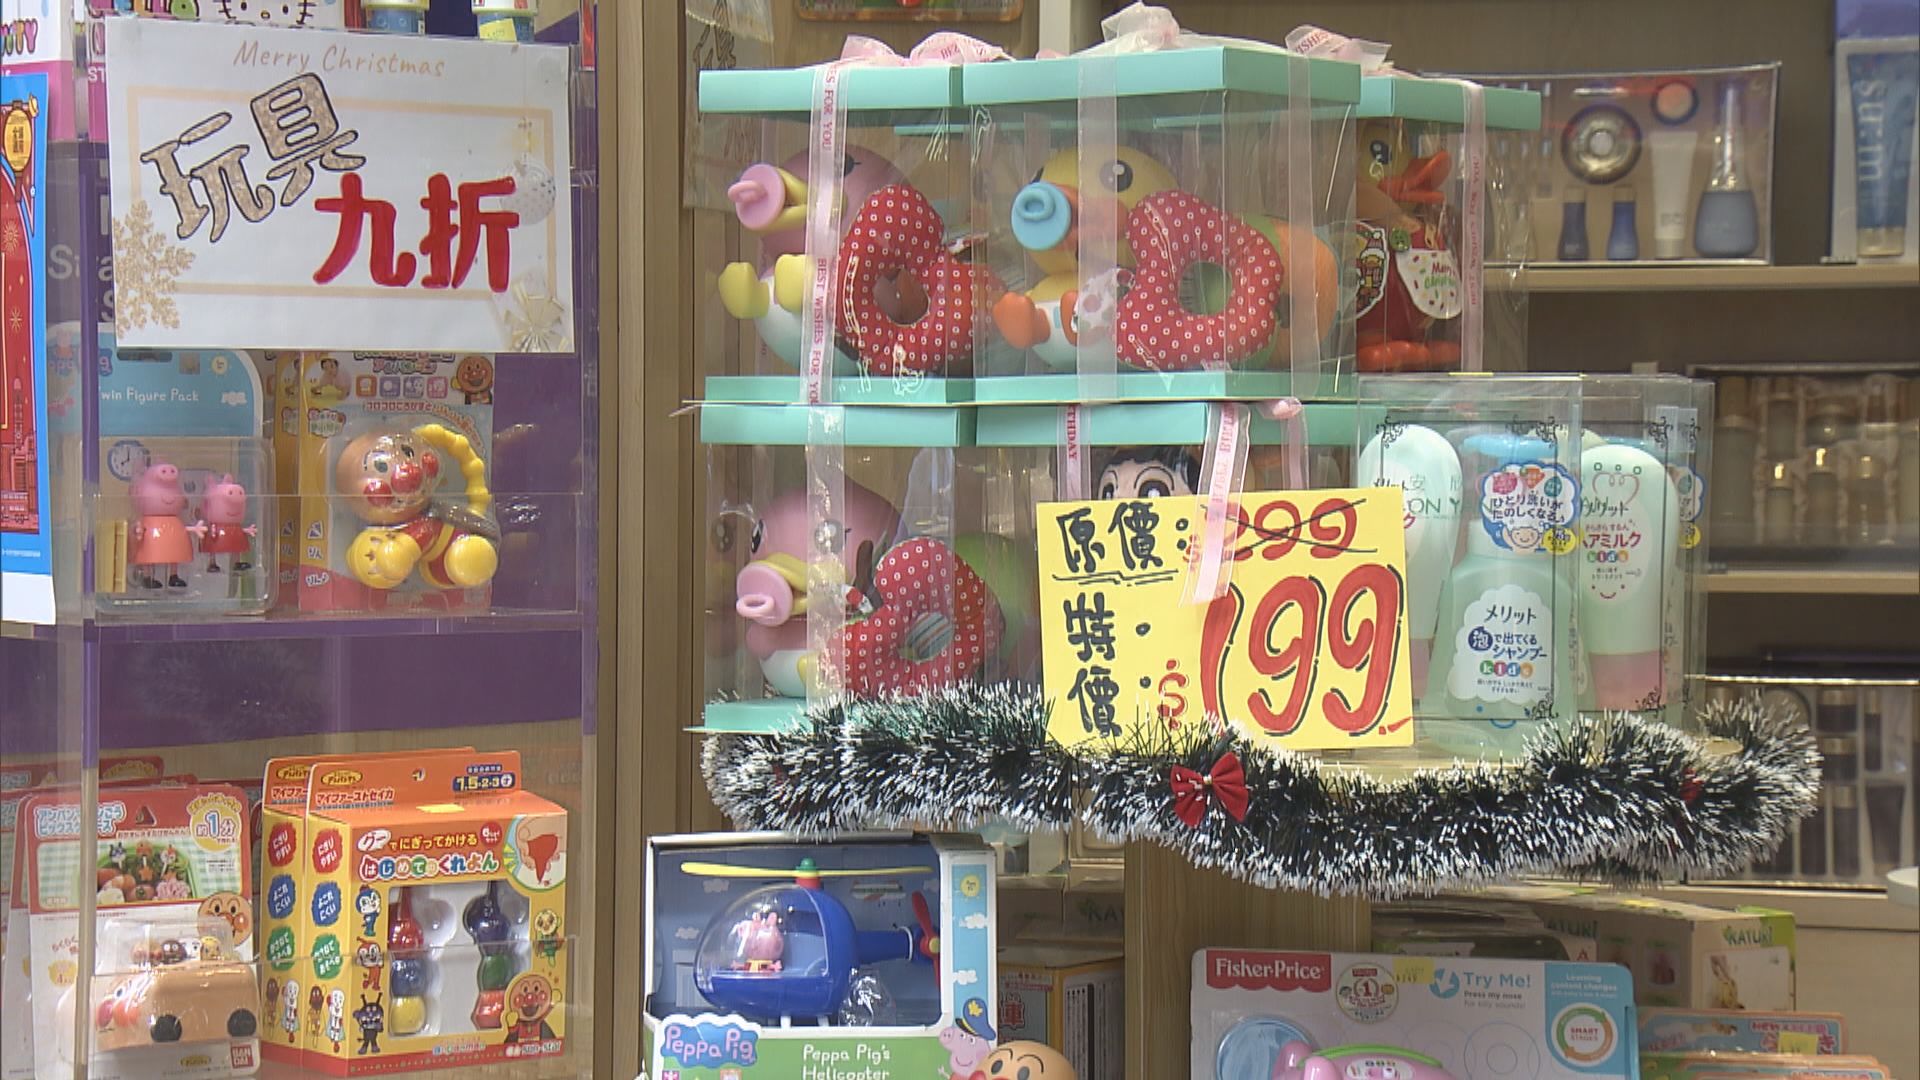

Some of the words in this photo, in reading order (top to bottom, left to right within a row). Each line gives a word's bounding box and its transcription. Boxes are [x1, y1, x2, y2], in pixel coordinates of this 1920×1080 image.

[233, 40, 310, 73] Merry
[322, 44, 446, 78] Christmas
[823, 90, 834, 115] FOR
[140, 72, 367, 243] 玩具
[313, 171, 520, 293] 九折
[816, 258, 827, 289] BEST
[814, 296, 825, 344] WISHES
[810, 350, 821, 375] FOR
[126, 386, 167, 405] Figure
[171, 387, 199, 401] Pack
[1484, 604, 1537, 626] メリット
[1470, 629, 1538, 650] 泡で出てくる
[1493, 644, 1548, 661] シャンプー
[361, 851, 499, 881] はじめてのくれよん
[1216, 957, 1321, 980] Fisher-Price
[1464, 972, 1494, 990] Try
[1500, 973, 1530, 988] Me!
[665, 1026, 722, 1062] Peppa
[726, 1028, 754, 1062] Pig
[803, 1044, 850, 1066] Peppa
[857, 1043, 891, 1065] Pig's
[802, 1065, 891, 1080] Helicopter
